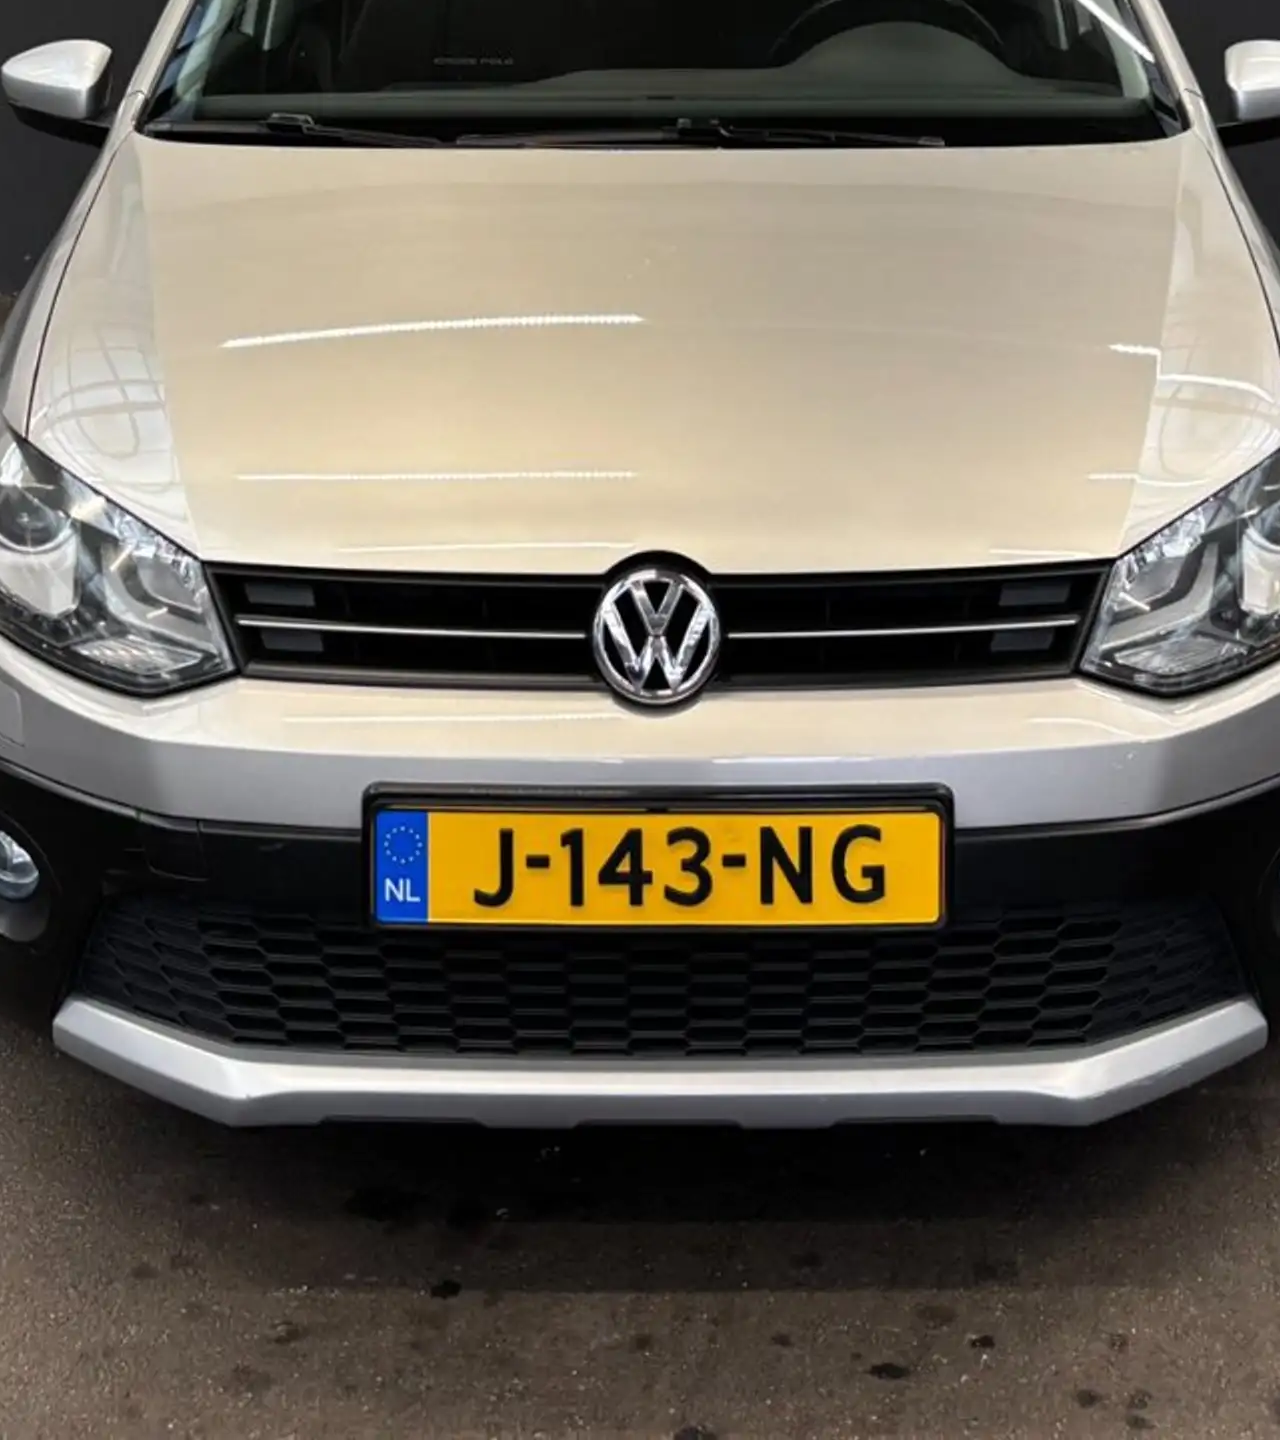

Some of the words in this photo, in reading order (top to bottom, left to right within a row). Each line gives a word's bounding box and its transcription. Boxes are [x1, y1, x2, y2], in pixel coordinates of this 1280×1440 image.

[597, 573, 717, 698] VW
[385, 878, 420, 902] NL
[473, 824, 886, 908] J-143-NG
